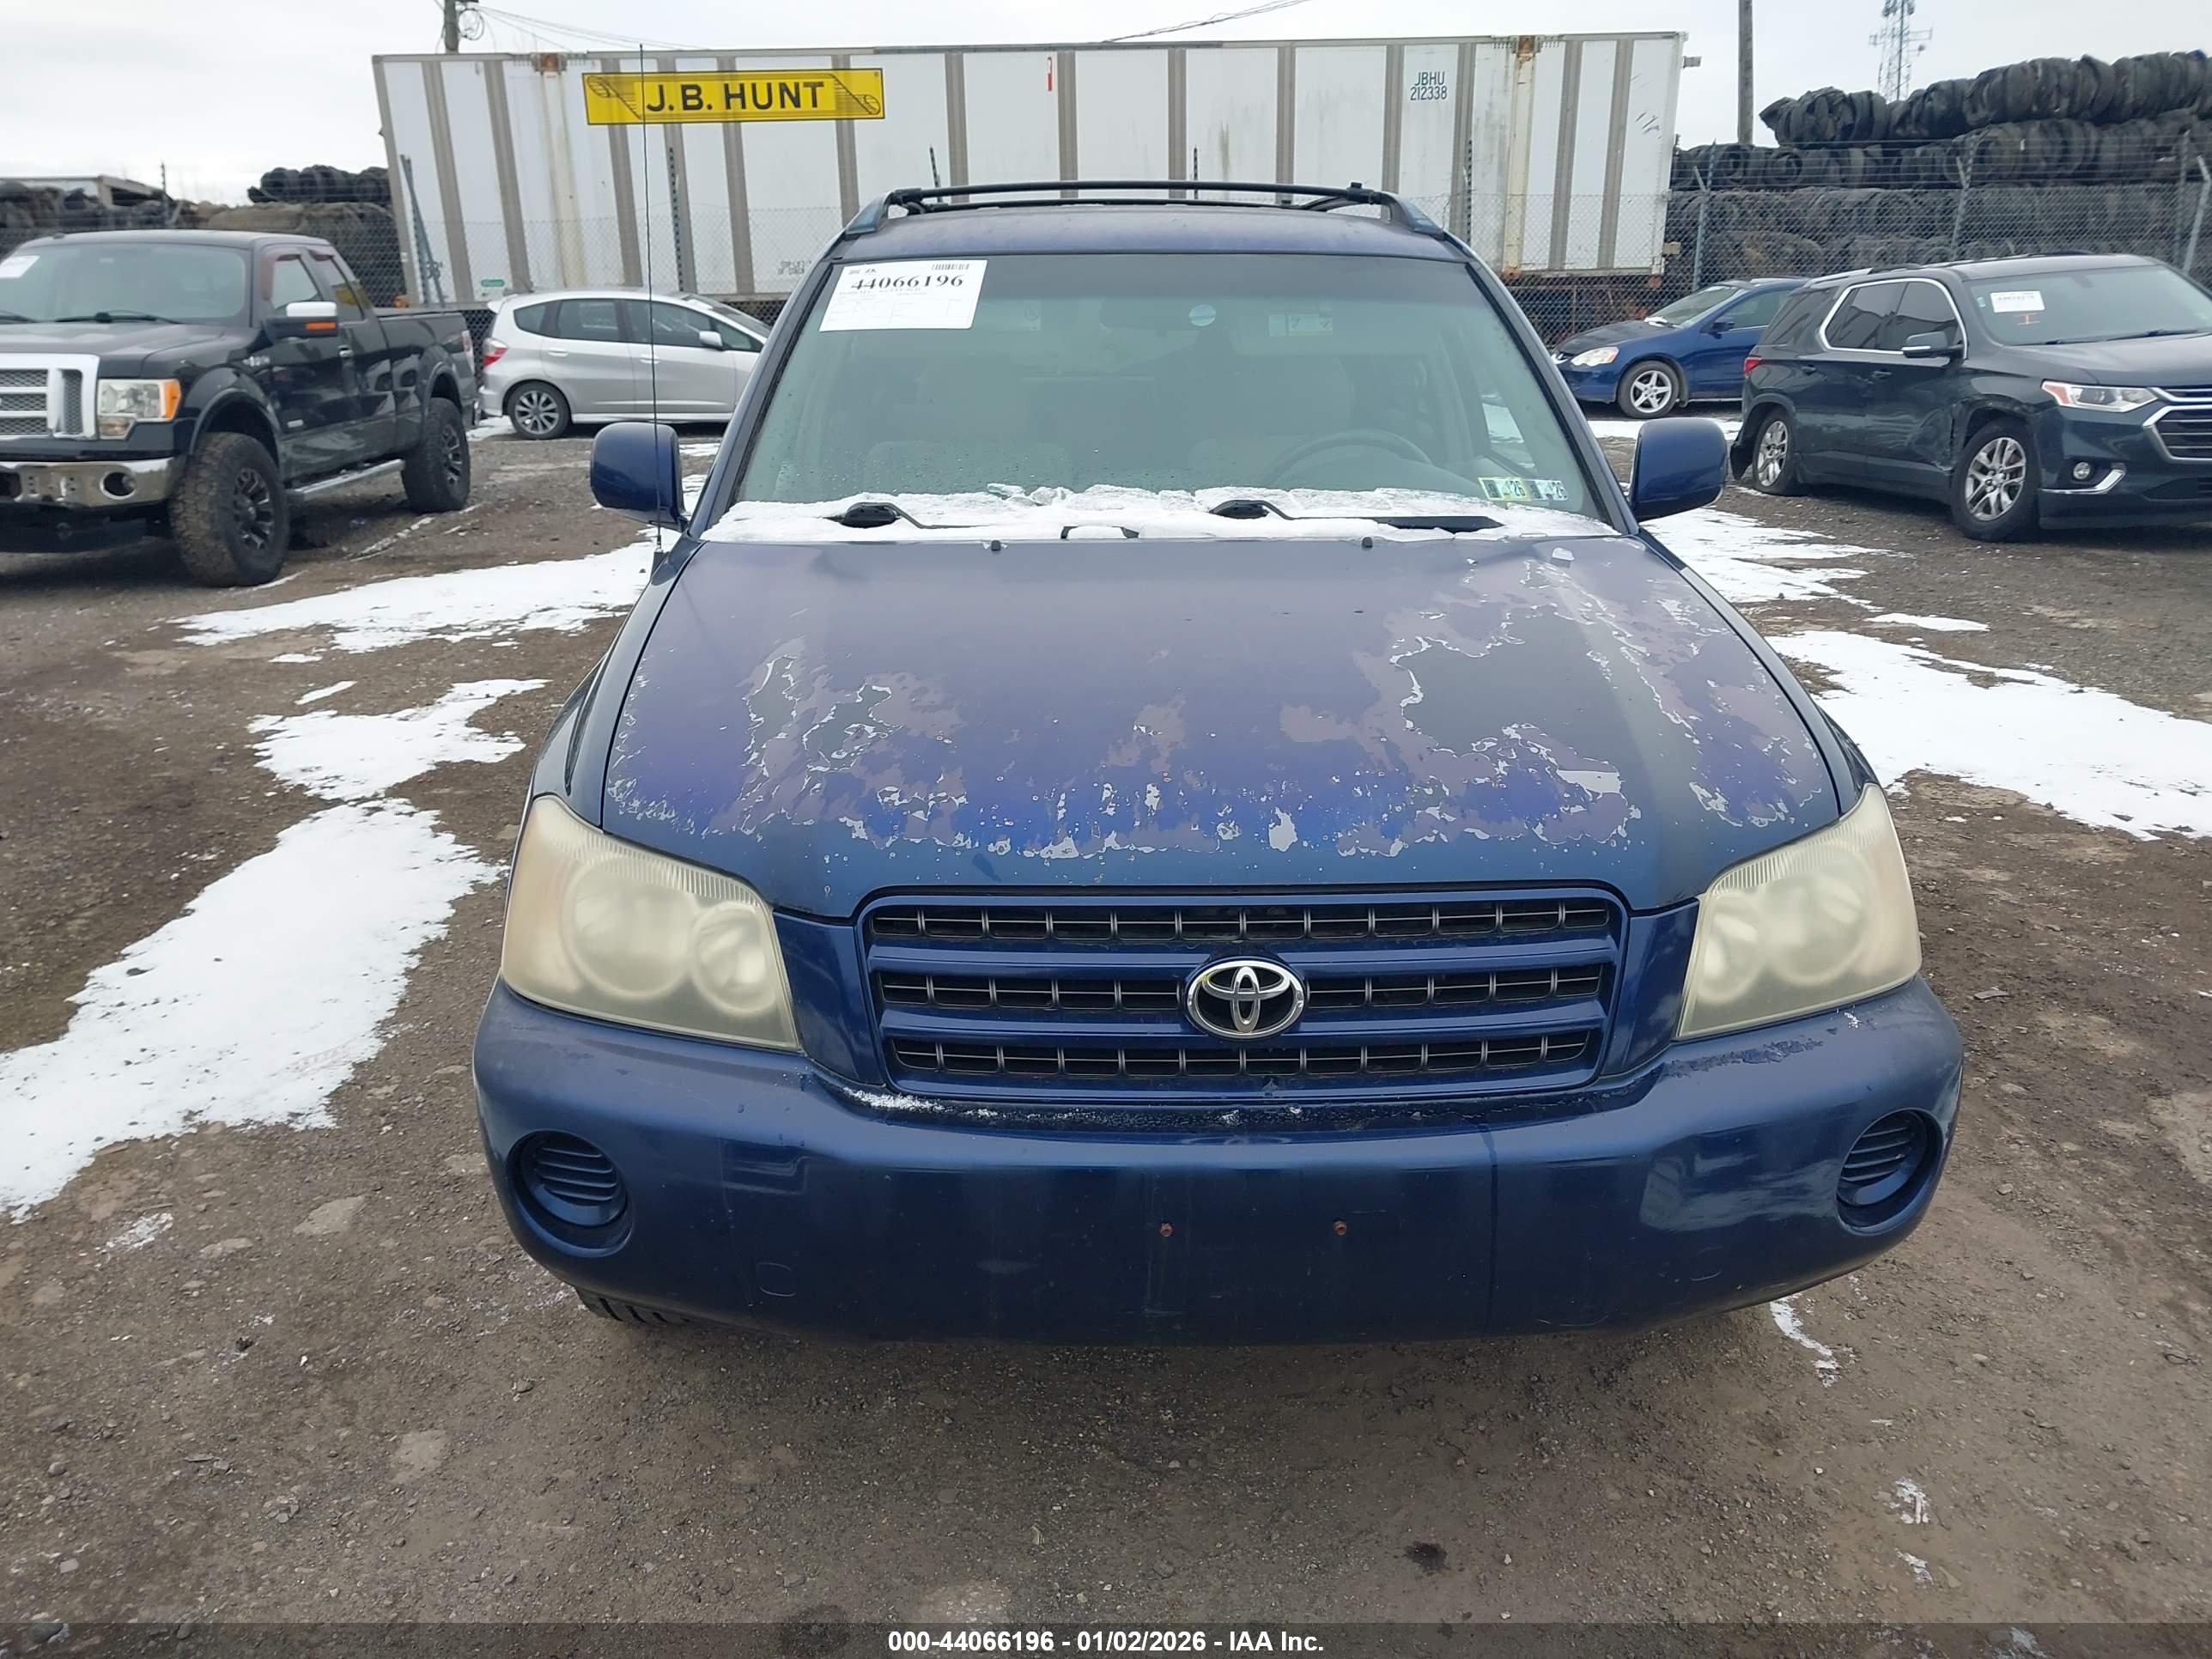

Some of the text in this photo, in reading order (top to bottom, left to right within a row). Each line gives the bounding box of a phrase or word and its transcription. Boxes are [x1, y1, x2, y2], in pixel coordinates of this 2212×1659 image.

[1414, 70, 1445, 86] JBHU
[723, 81, 825, 111] HUNT
[1409, 85, 1448, 100] 212338
[850, 274, 964, 290] 44066196
